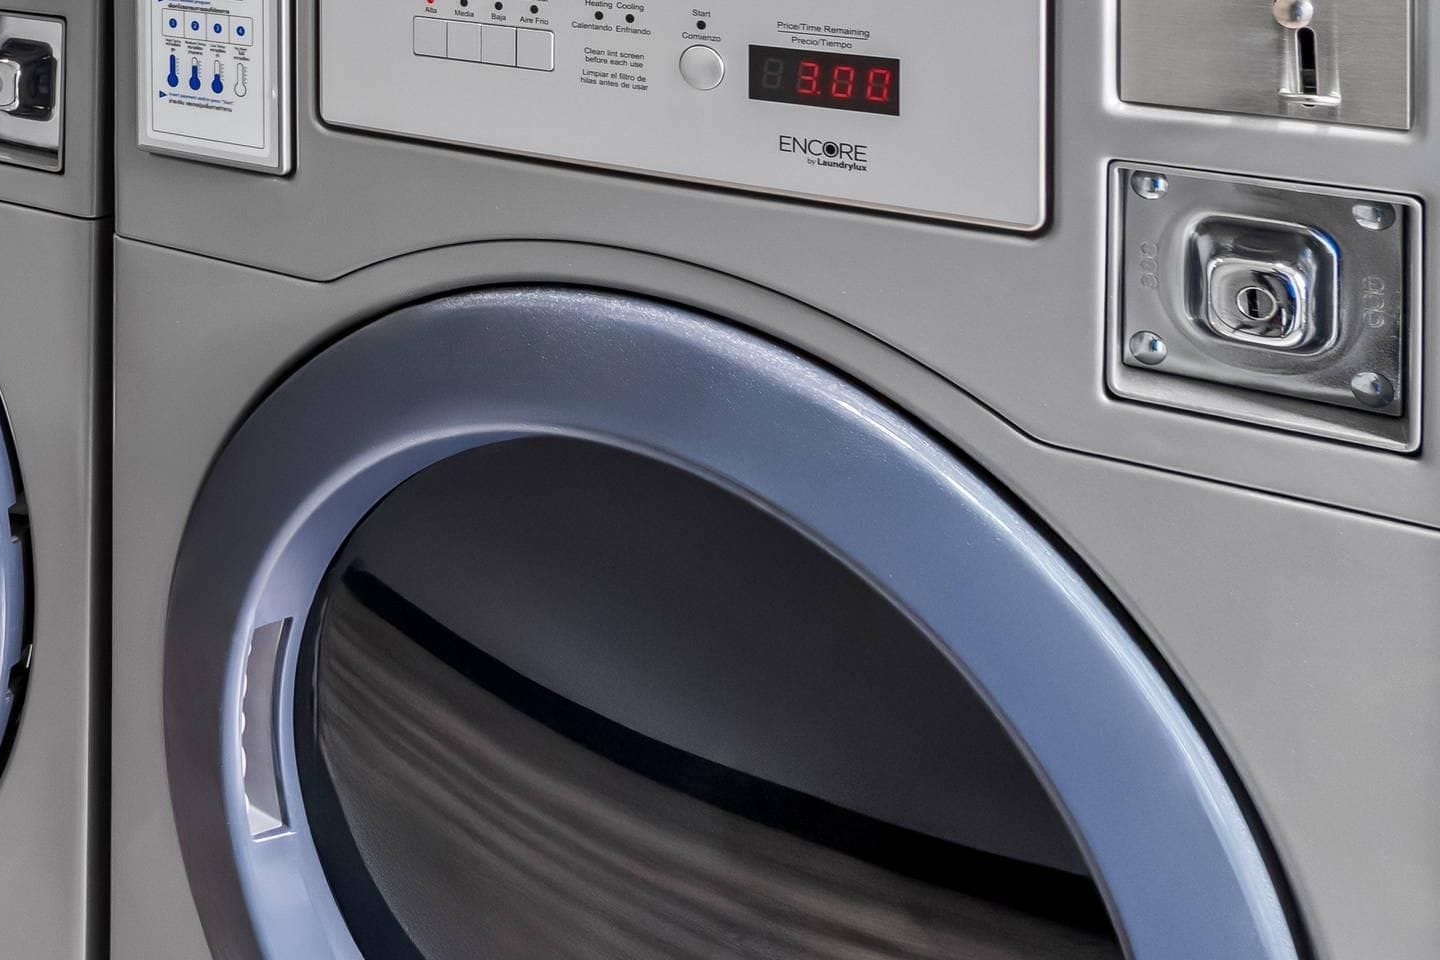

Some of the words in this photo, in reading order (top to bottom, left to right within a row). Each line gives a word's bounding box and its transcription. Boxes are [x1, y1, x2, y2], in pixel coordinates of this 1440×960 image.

[585, 0, 612, 9] Heating
[616, 2, 644, 12] Cooling
[491, 13, 507, 22] Baja
[692, 9, 711, 17] Start
[572, 21, 612, 31] Calentando
[777, 22, 821, 33] Price/Time
[823, 26, 870, 37] Remaining
[682, 32, 721, 42] Comienzo
[791, 36, 853, 49] Precio/Tiempo
[584, 47, 605, 55] Clean
[620, 52, 644, 60] screen
[585, 56, 608, 64] before
[780, 136, 868, 162] ENCORE
[817, 158, 868, 171] Laundrylux
